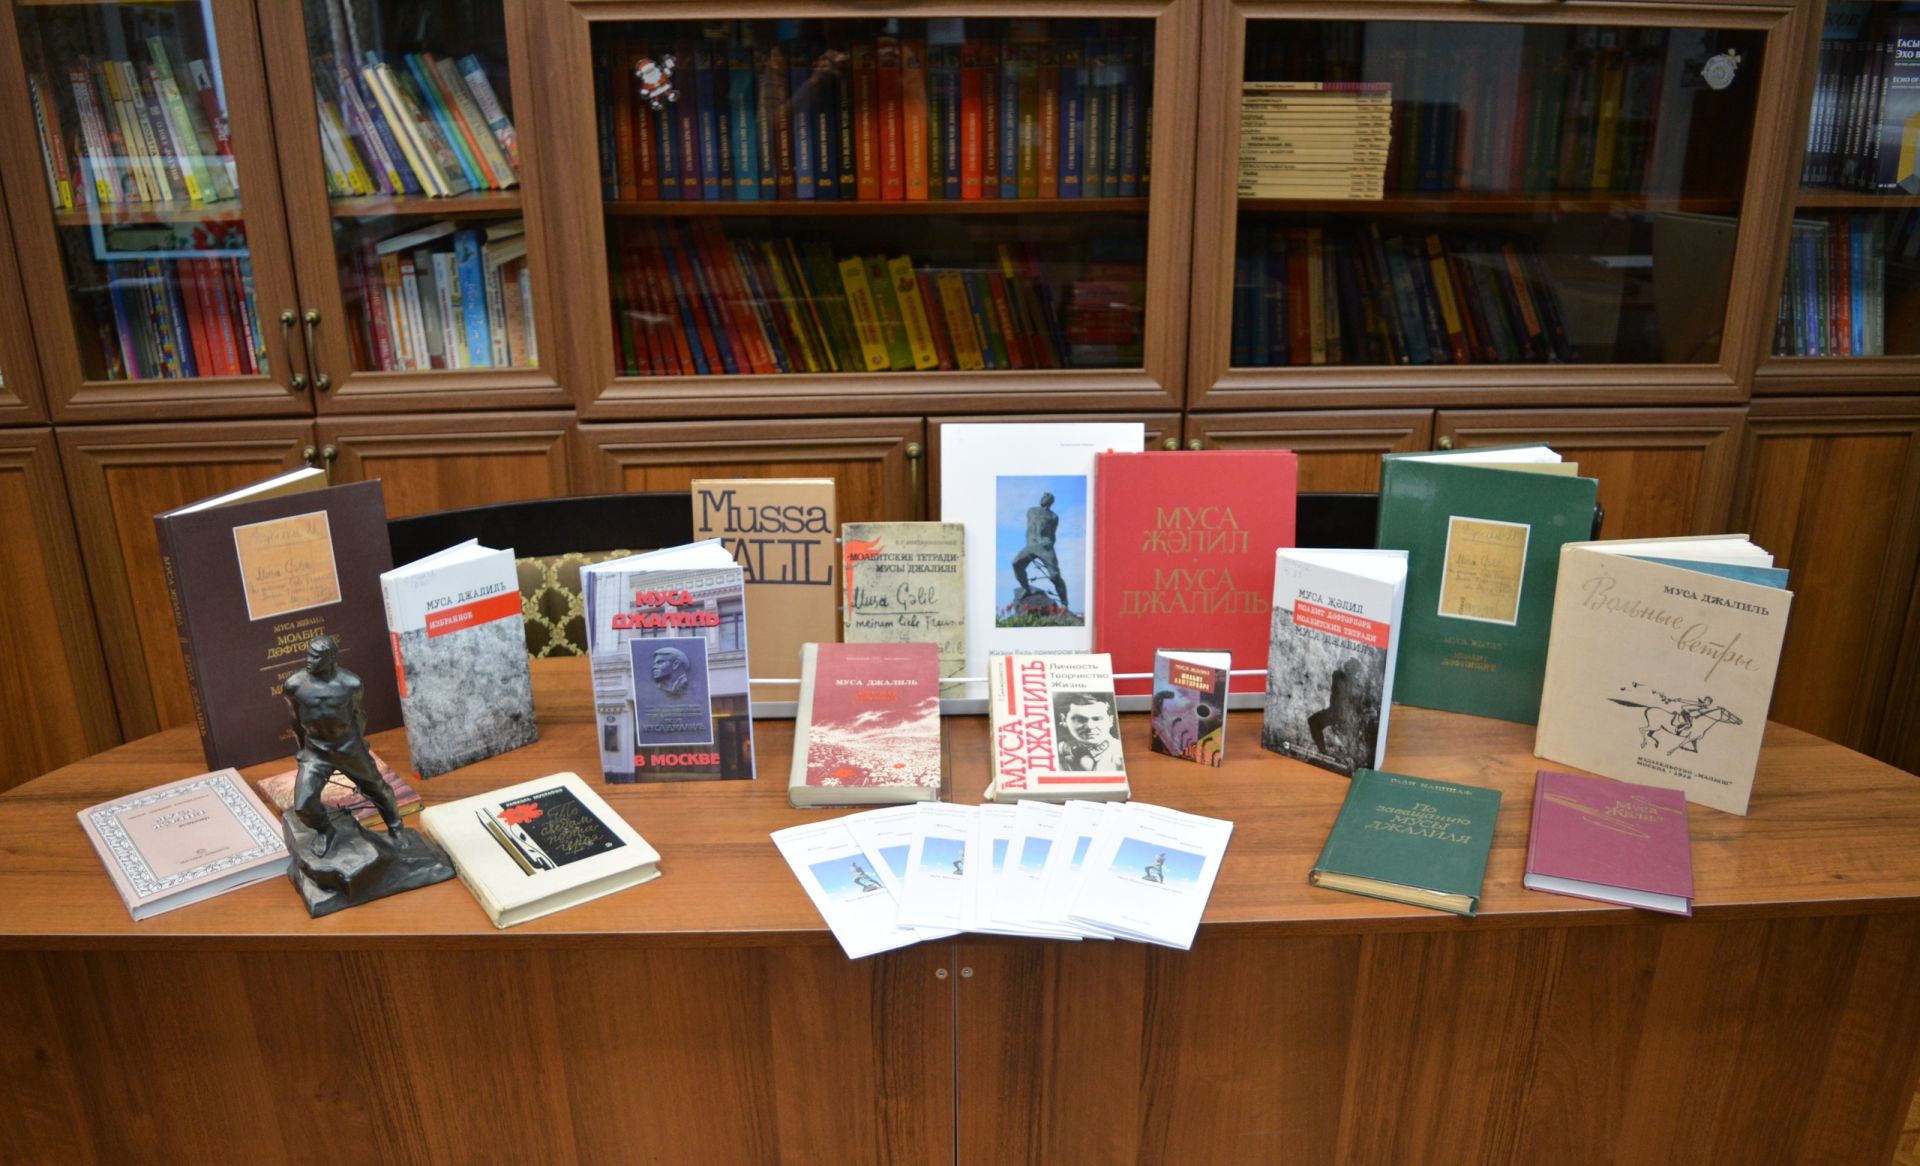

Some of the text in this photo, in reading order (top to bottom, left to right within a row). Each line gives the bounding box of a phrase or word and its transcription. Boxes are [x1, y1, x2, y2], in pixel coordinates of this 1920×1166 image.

[698, 490, 832, 534] Mussa
[1156, 507, 1239, 530] МУСА
[876, 564, 957, 573] МУСЫ ДЖАЛИЛЯ
[1154, 569, 1237, 592] МУСА
[426, 582, 507, 611] МУСА ДЖАЛИЛЬ
[635, 590, 694, 608] МУСА
[1120, 591, 1271, 617] ДЖАЛИЛЬ
[1298, 589, 1324, 604] МУСА
[1664, 585, 1770, 616] МУСА ДЖАЛИЛЬ
[611, 611, 721, 630] ДЖАЛИЛЬ
[277, 626, 326, 645] МОАБИТ
[1295, 626, 1320, 641] МУСА
[1671, 623, 1761, 682] ветры
[1049, 663, 1099, 671] Личность
[1050, 672, 1109, 680] Творчество
[835, 679, 918, 687] МУСА ДЖАЛИЛЬ
[1051, 681, 1087, 689] Жизнь
[1021, 660, 1057, 772] ДЖАЛИЛЬ
[634, 752, 721, 768] В МОСКВЕ
[998, 719, 1028, 791] МУСА
[1636, 761, 1667, 773] МОСКВА
[1411, 802, 1437, 814] По
[1364, 820, 1472, 844] ДЖАЛИЛЯ
[1390, 815, 1451, 831] МУСЫ
